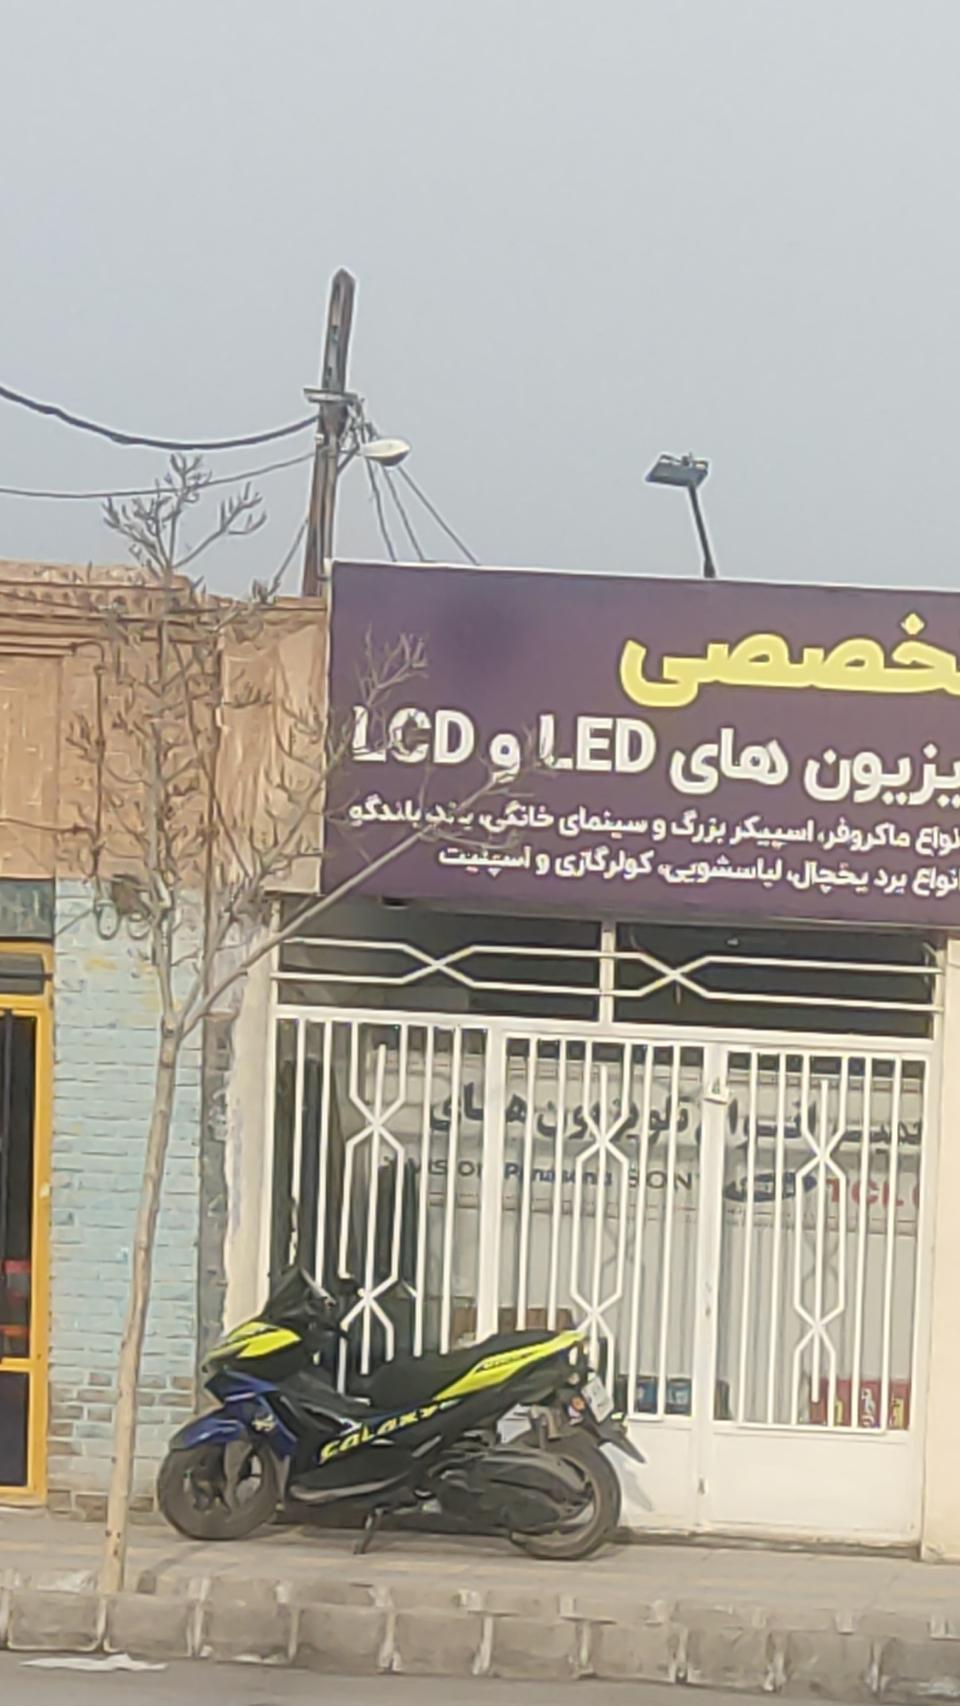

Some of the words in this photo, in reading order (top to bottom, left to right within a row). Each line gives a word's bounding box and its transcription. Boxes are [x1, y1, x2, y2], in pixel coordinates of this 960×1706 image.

[352, 704, 475, 765] LCD
[538, 713, 656, 773] LED
[489, 733, 521, 785] و
[669, 727, 789, 794] های
[558, 805, 649, 840] سینمای
[651, 818, 667, 841] و
[670, 809, 727, 844] بزرگ
[729, 814, 815, 850] اسپیکر
[535, 852, 551, 876] و
[873, 868, 908, 895] برد
[627, 1163, 706, 1192] SON
